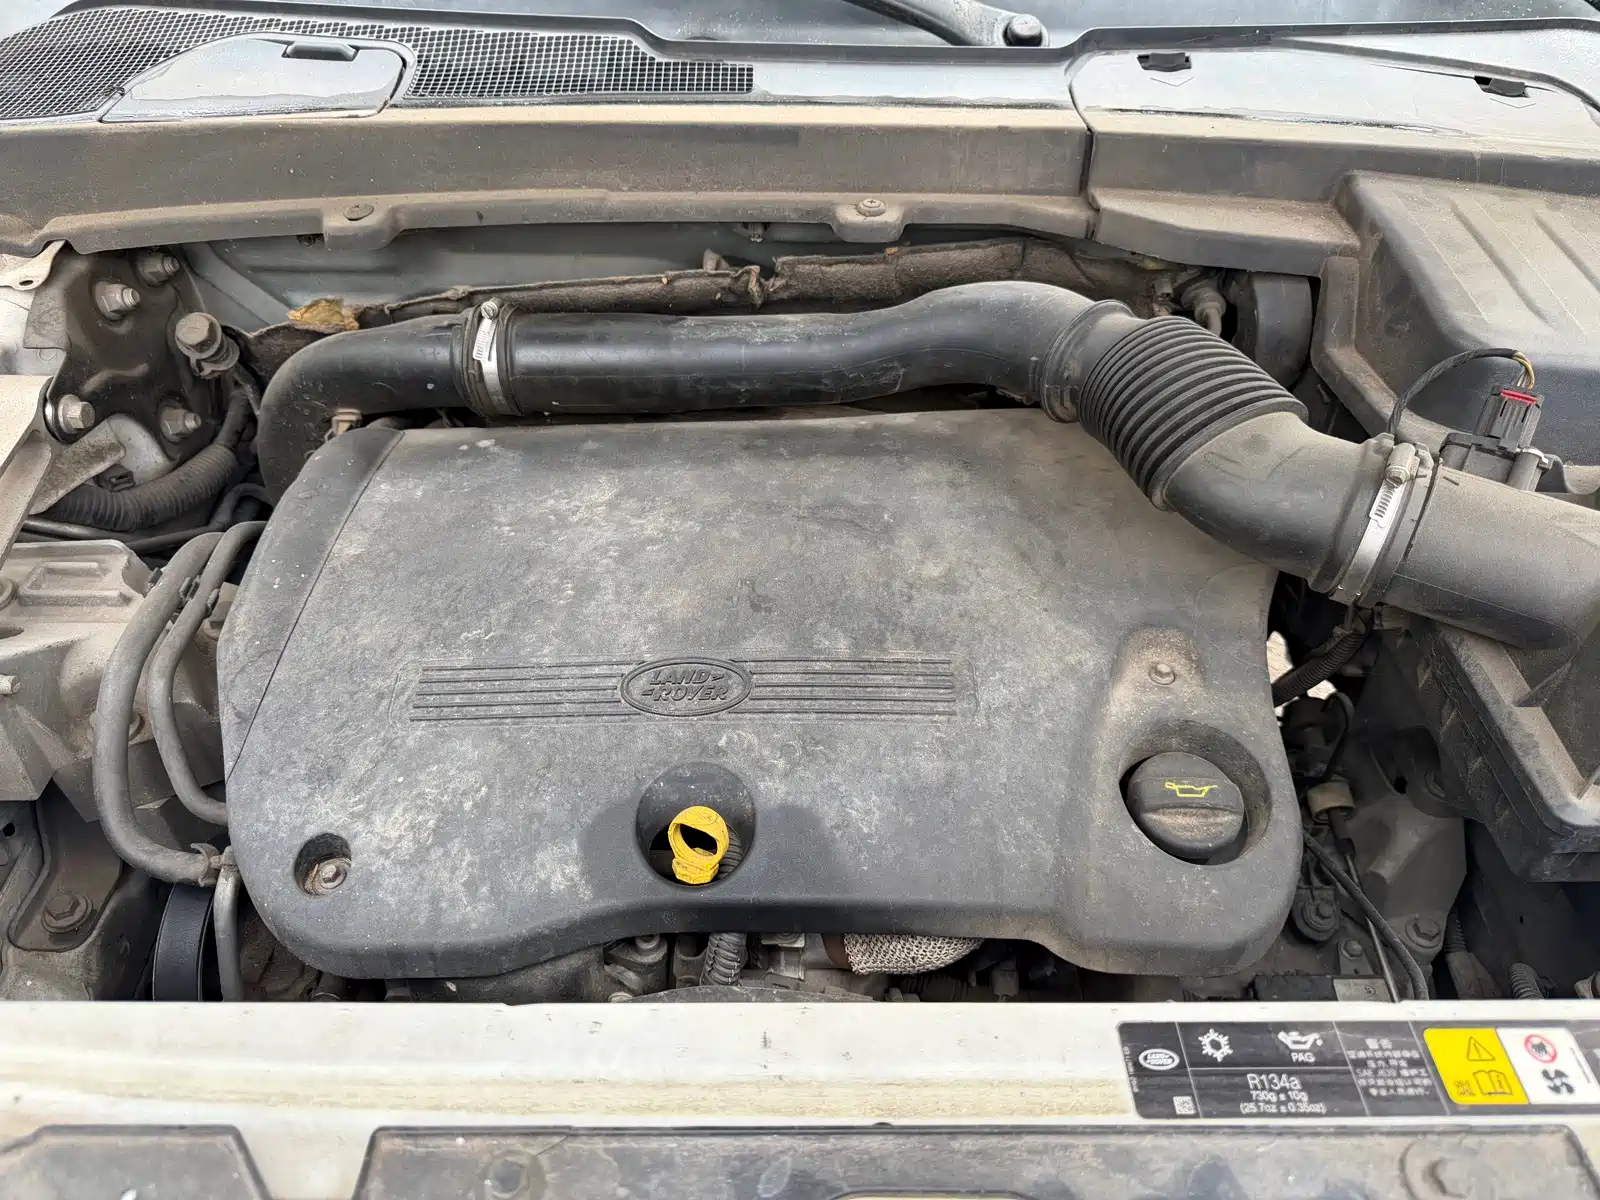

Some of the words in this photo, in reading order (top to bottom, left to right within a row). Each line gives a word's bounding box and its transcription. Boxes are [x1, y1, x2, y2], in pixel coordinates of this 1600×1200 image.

[649, 669, 712, 686] LAND
[652, 685, 729, 702] ROVER
[1290, 1052, 1316, 1063] PAG
[1246, 1073, 1303, 1091] R134a
[1250, 1090, 1278, 1103] 730g
[1288, 1090, 1309, 1103] 10g
